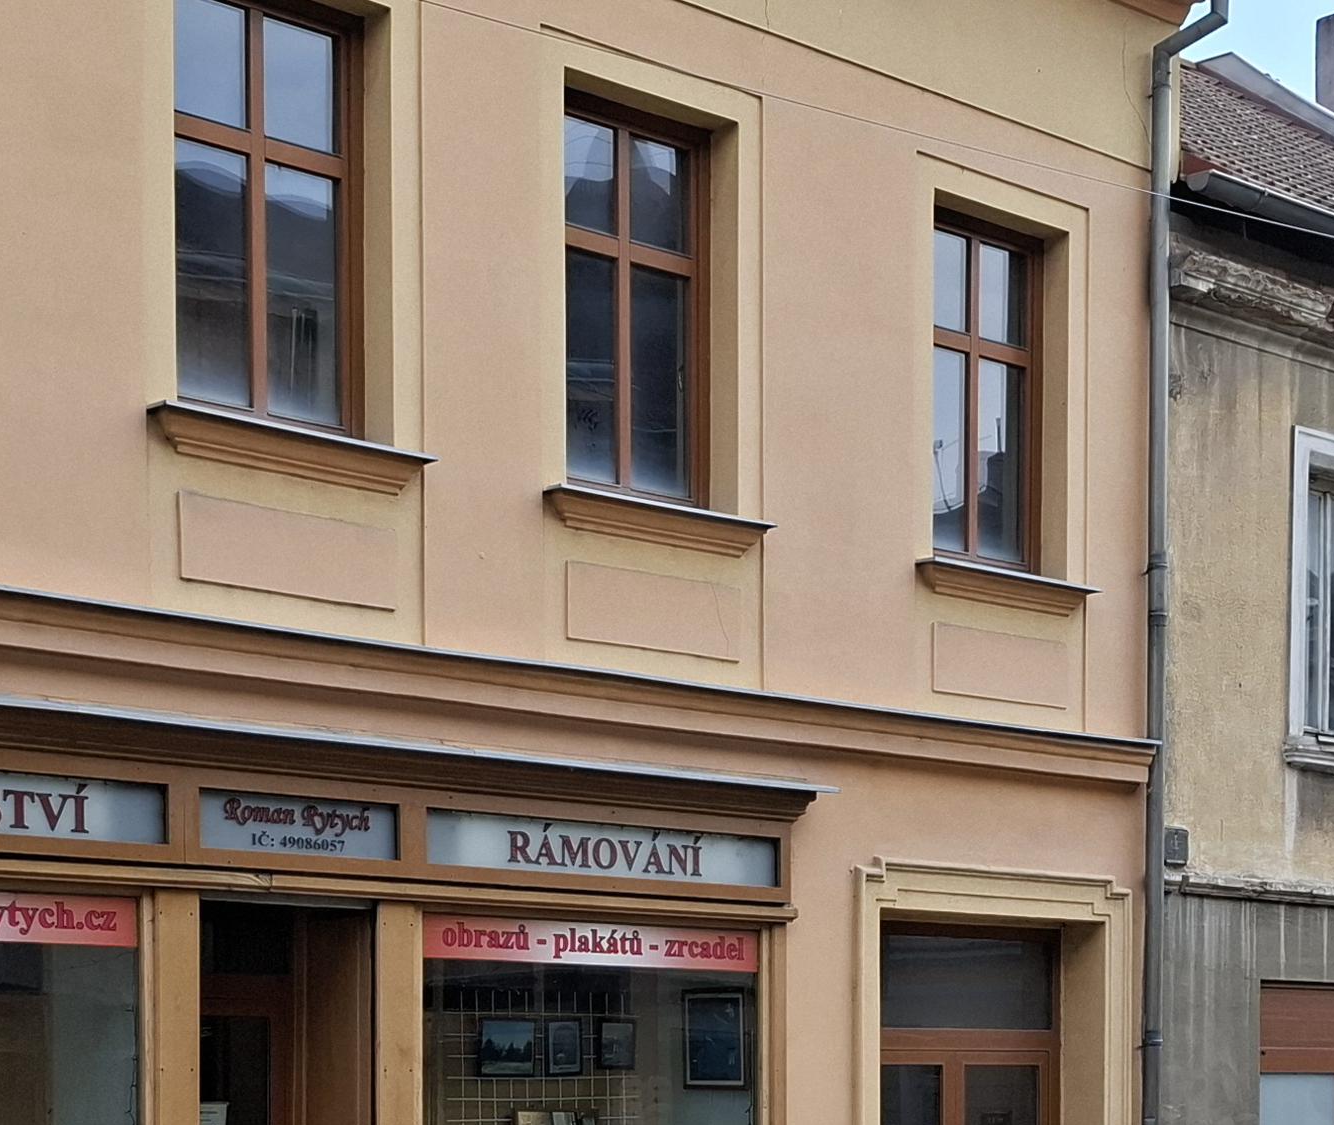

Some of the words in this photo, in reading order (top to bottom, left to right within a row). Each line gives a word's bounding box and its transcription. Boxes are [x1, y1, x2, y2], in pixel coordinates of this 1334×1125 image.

[223, 798, 296, 826] Roman
[301, 804, 371, 837] Rytych
[251, 830, 275, 847] IČ:
[279, 835, 345, 852] 49086057
[506, 822, 704, 877] RÁMOVÁNÍ
[441, 921, 530, 951] obrazů
[552, 927, 643, 959] plakátů
[664, 936, 746, 961] zrcadel
